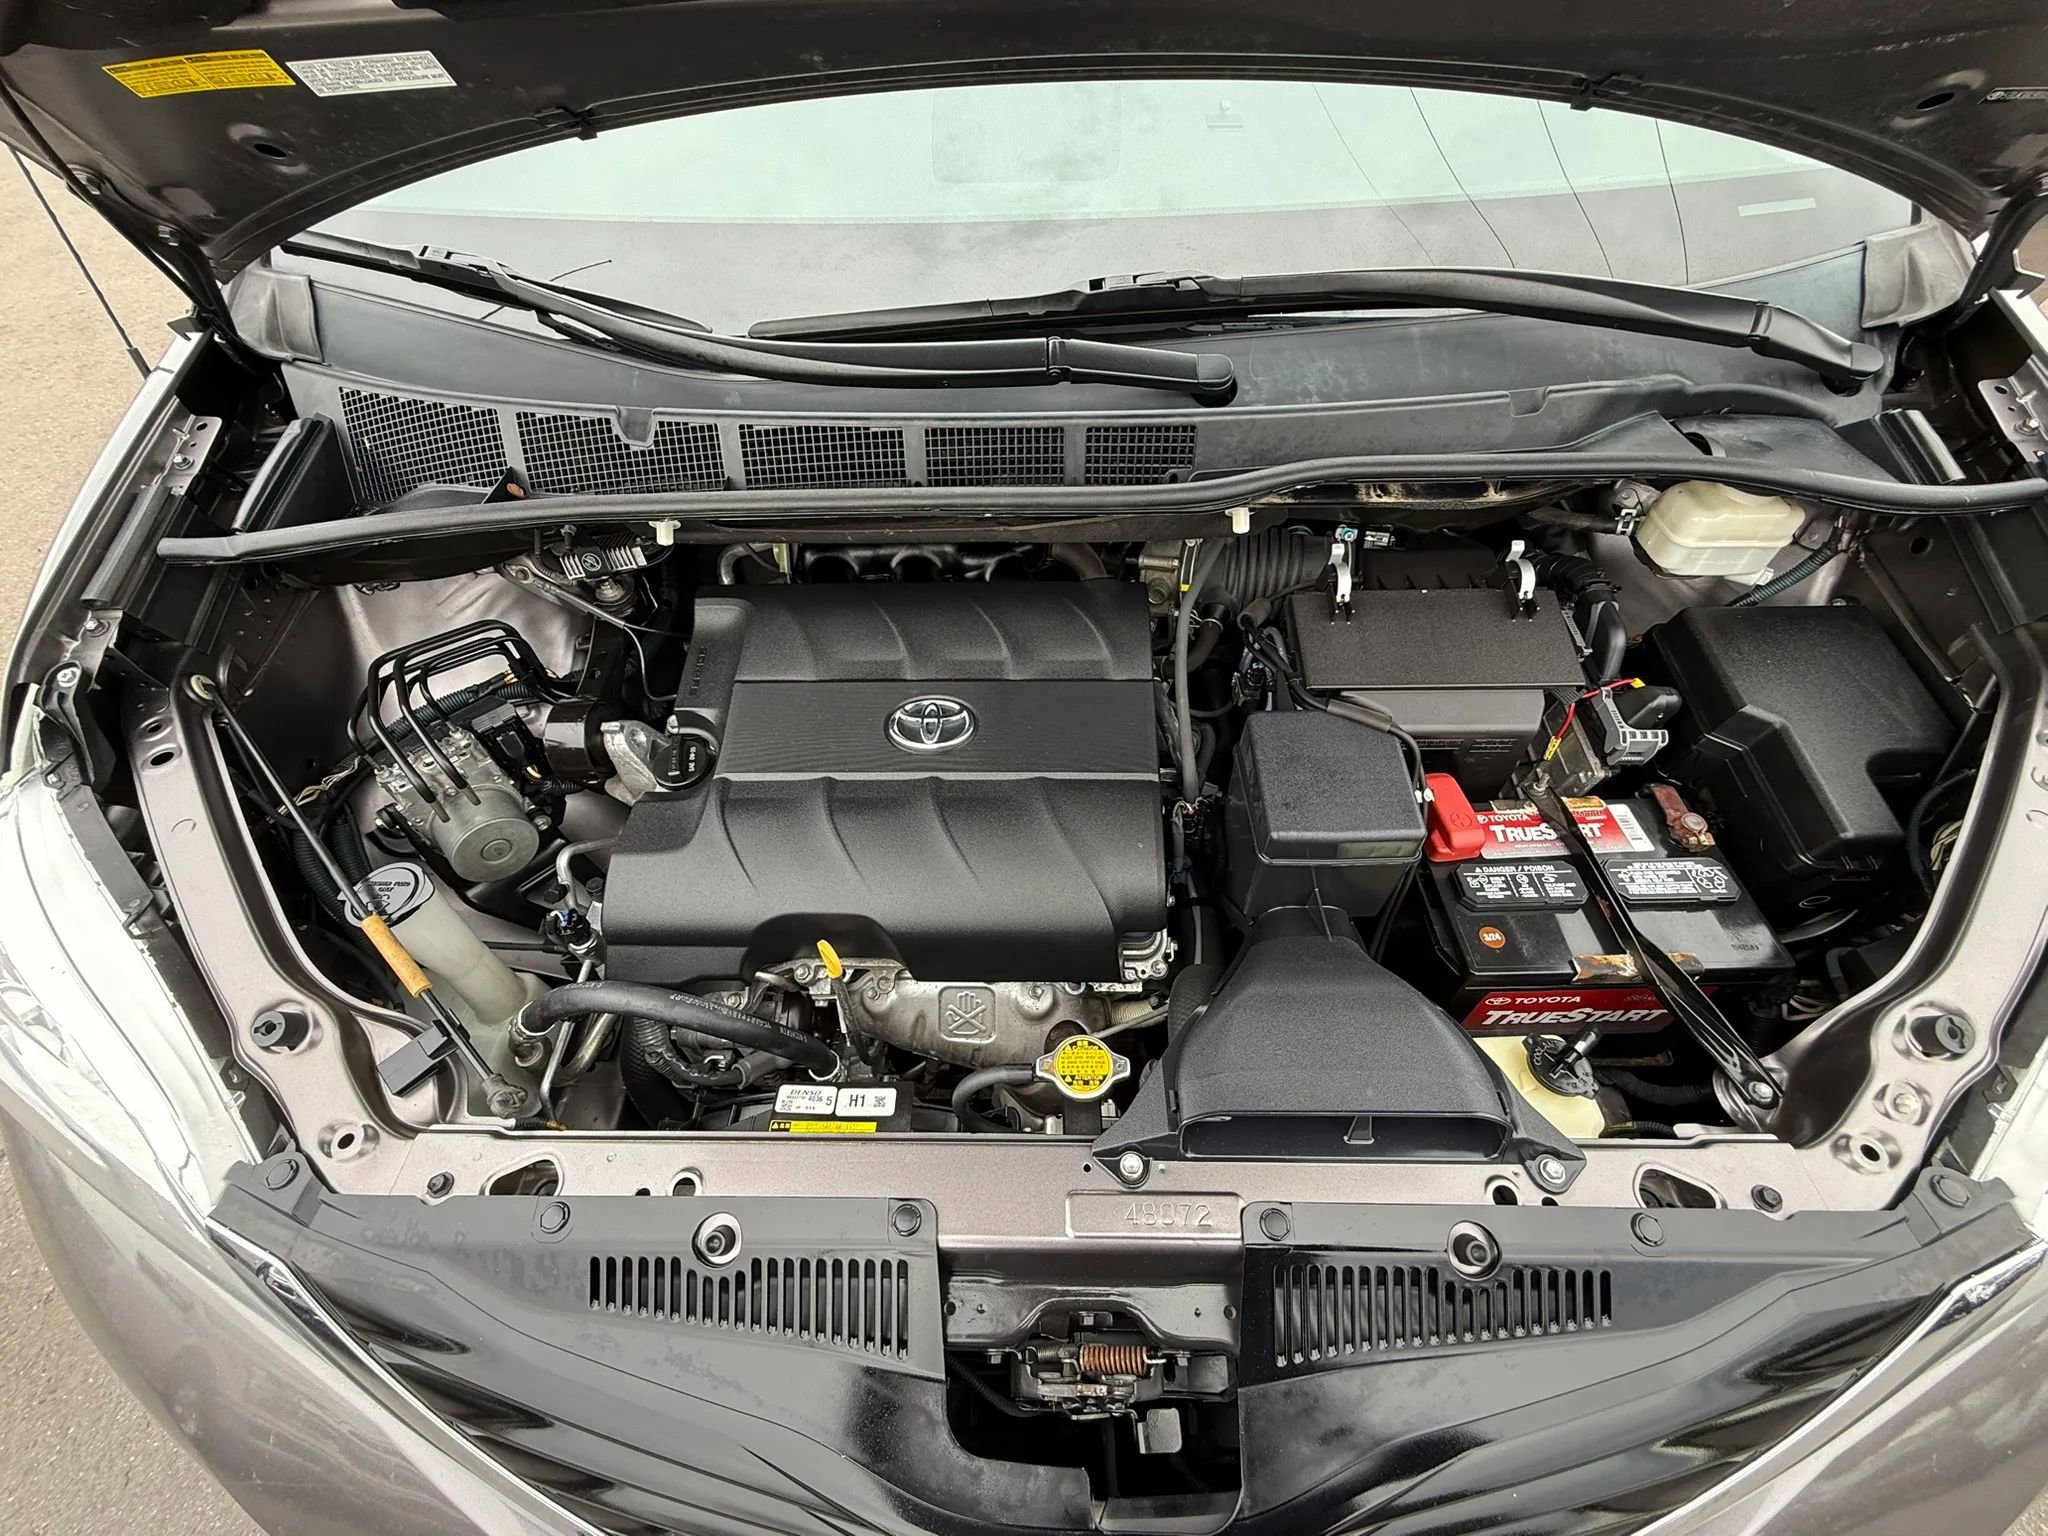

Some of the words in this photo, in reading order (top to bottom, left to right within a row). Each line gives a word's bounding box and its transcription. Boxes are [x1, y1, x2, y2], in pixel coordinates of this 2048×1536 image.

[1489, 814, 1530, 823] TOYOTA
[1482, 866, 1516, 874] DANGER
[1523, 864, 1555, 873] POISON
[1515, 996, 1581, 1004] TOYOTA
[825, 1096, 833, 1106] 5
[849, 1094, 866, 1107] H1
[1125, 1202, 1211, 1227] 48072
